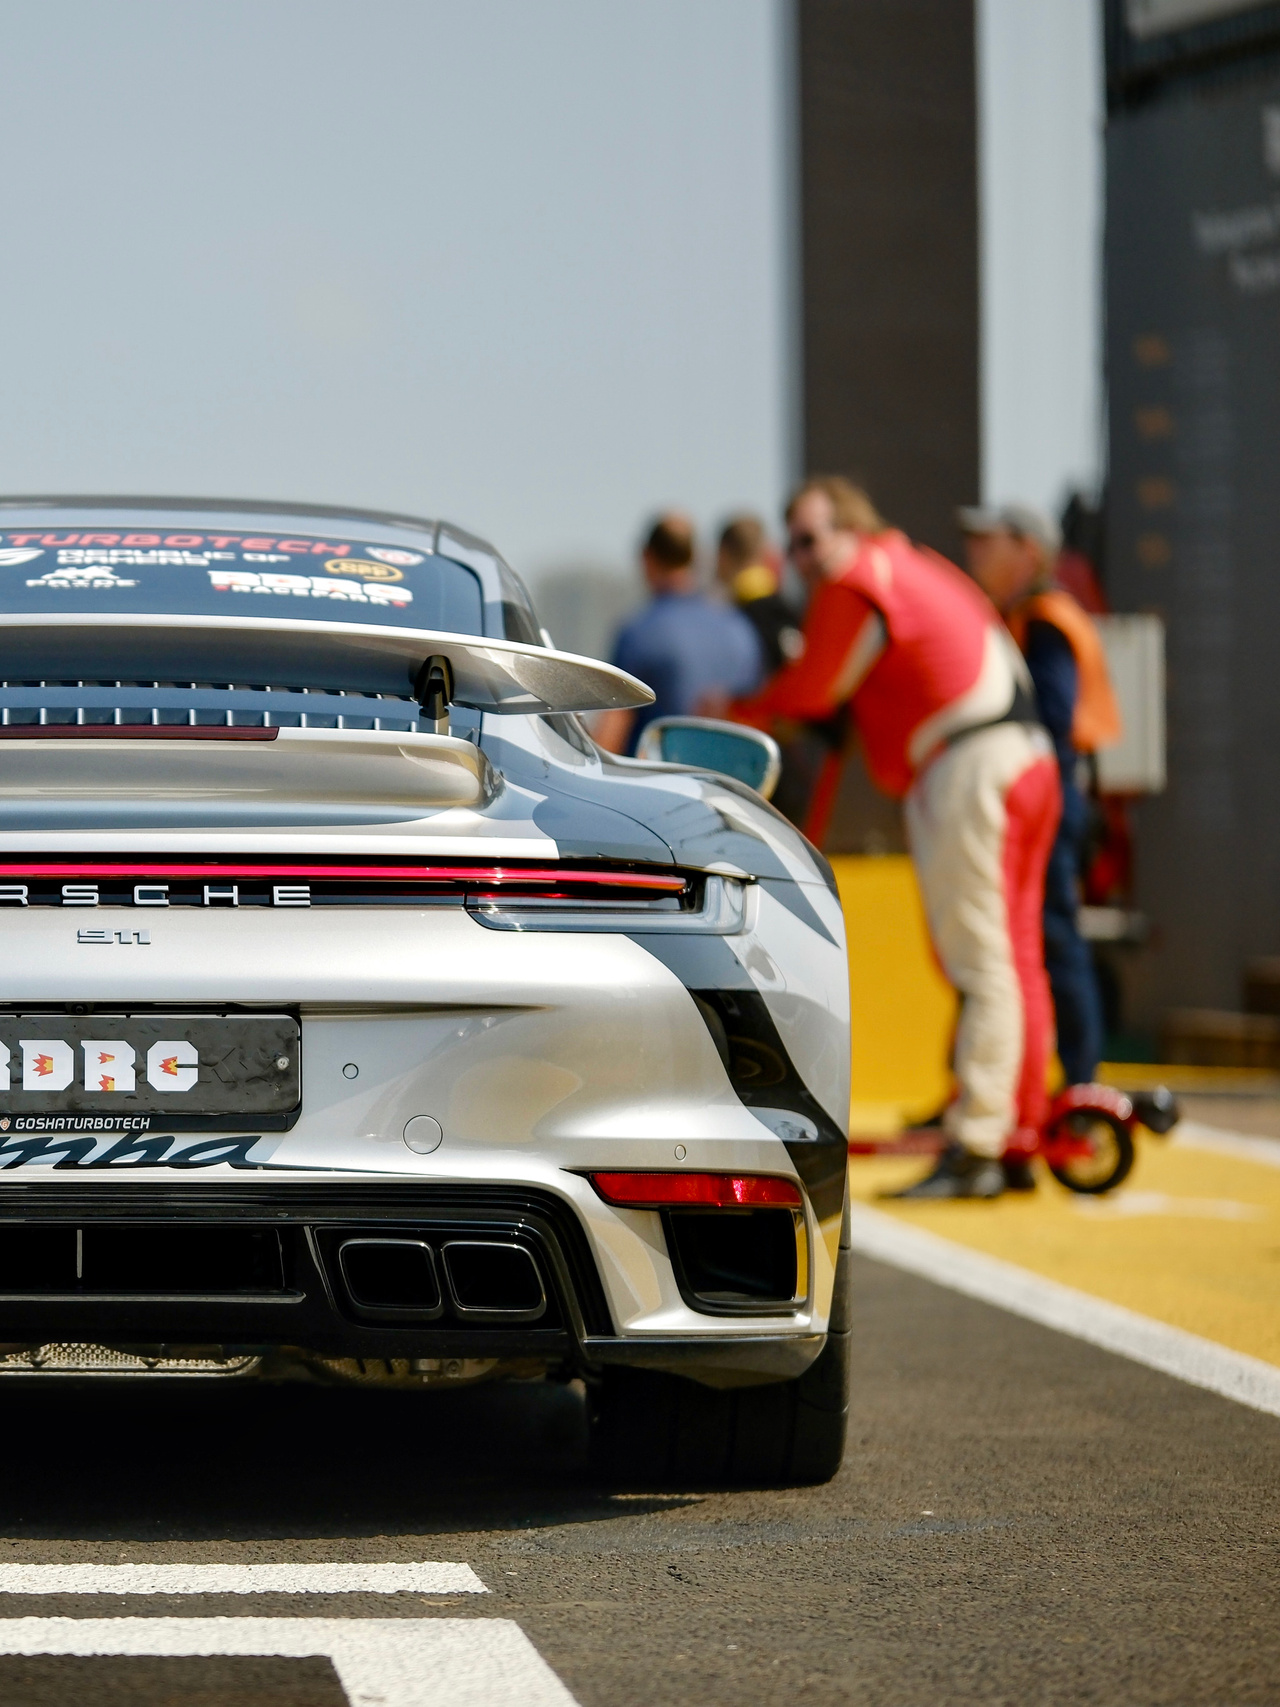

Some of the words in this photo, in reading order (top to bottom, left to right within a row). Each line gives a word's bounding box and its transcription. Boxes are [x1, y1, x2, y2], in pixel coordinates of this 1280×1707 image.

[7, 534, 352, 556] TURBOTECH
[77, 928, 151, 945] 911
[15, 1117, 151, 1131] GOSHATURBOTECH
